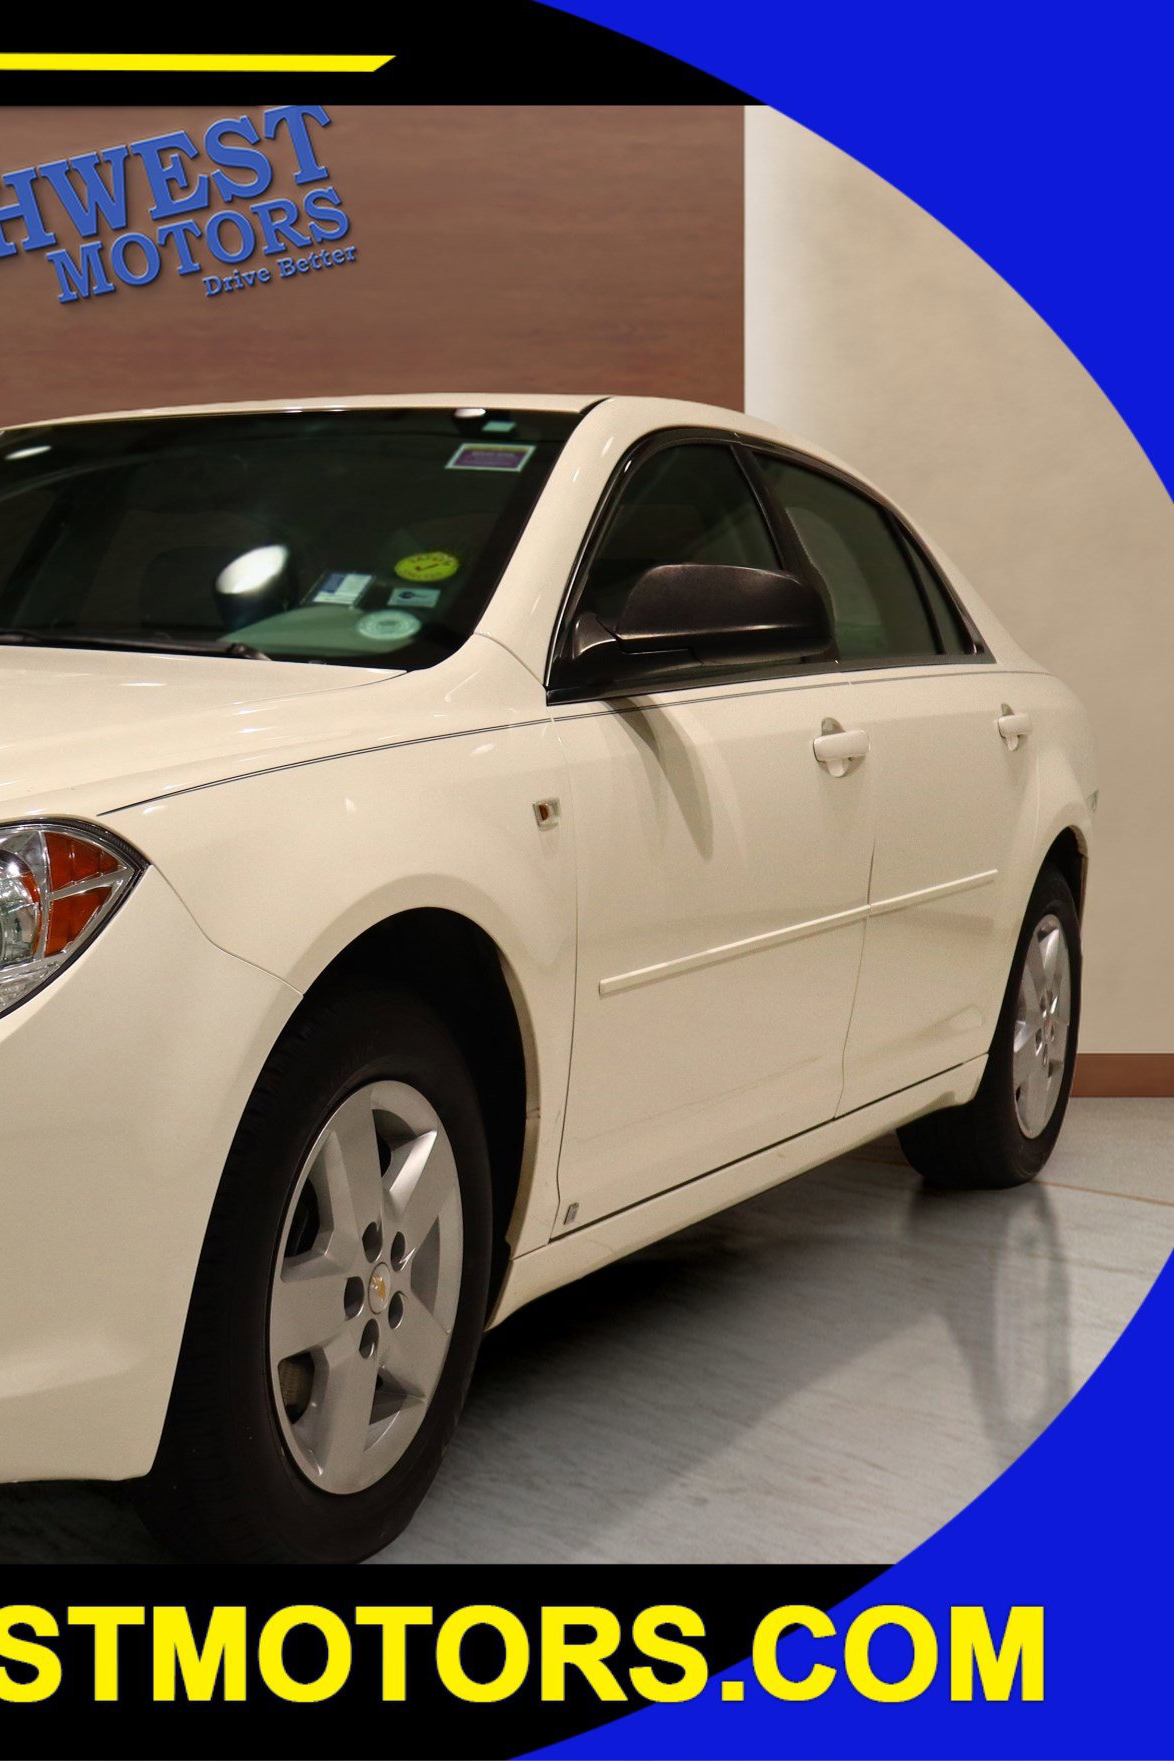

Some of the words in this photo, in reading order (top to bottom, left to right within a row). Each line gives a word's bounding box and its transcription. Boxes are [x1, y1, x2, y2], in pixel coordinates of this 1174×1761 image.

[46, 187, 350, 303] MOTORS
[203, 266, 271, 296] Drive
[278, 244, 357, 278] Better
